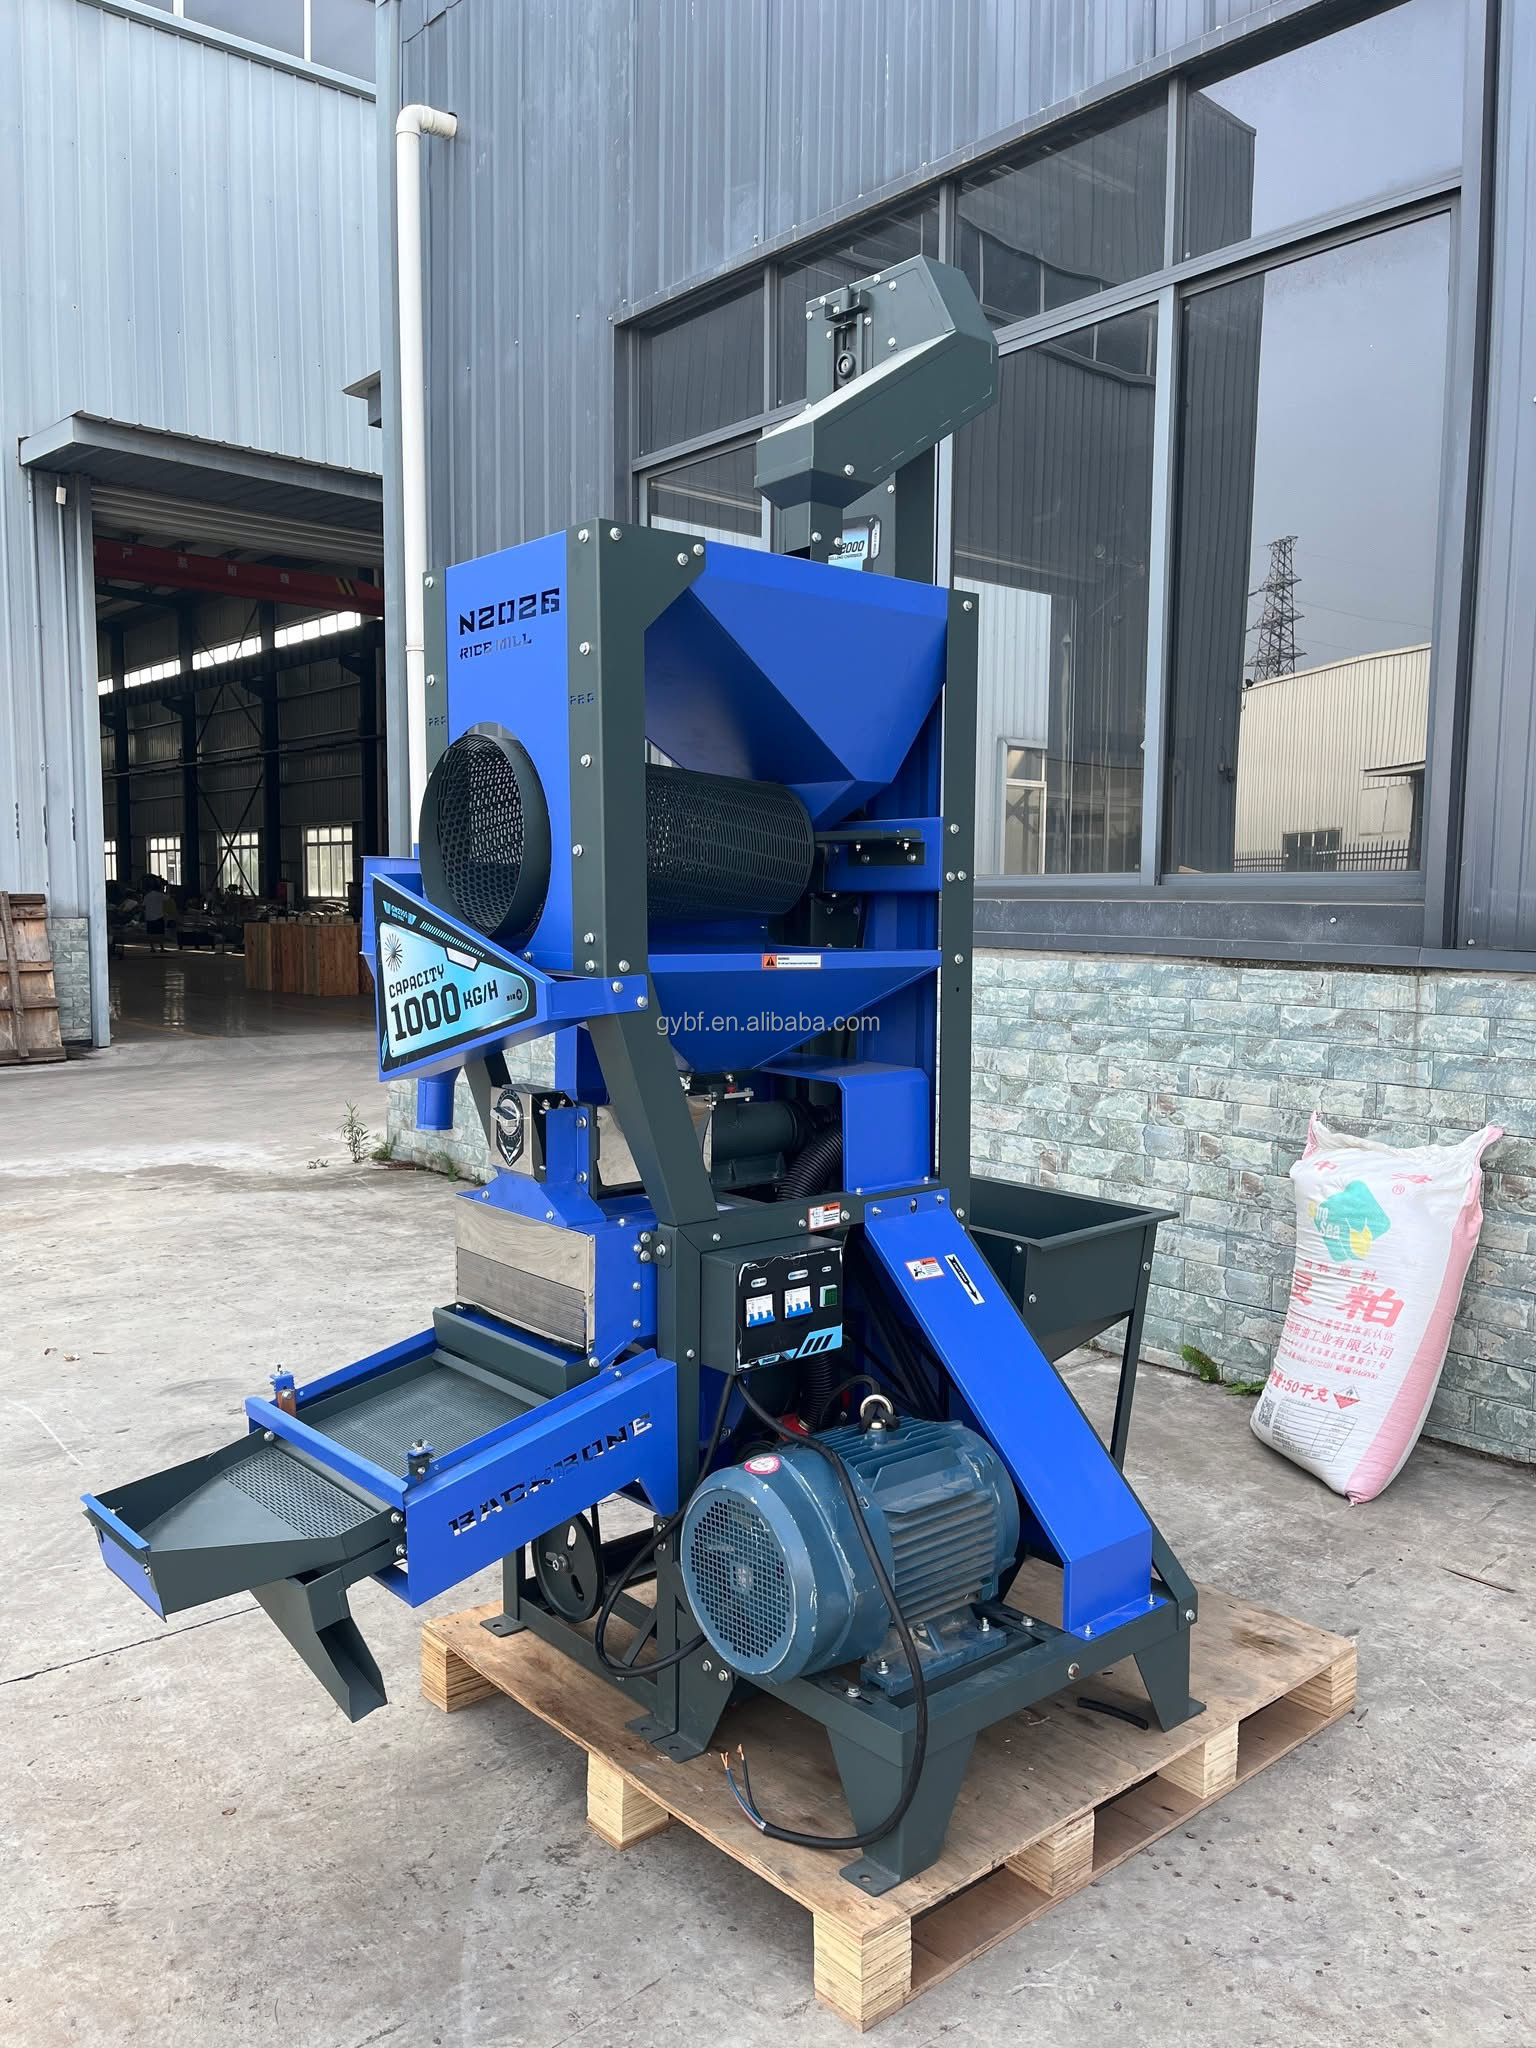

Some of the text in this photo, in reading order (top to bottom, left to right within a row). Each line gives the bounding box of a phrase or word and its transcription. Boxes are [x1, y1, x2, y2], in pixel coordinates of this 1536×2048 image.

[459, 587, 560, 636] N2026
[459, 633, 532, 660] RICE MILL
[388, 963, 445, 999] CAPACITY
[391, 979, 499, 1042] 1000 KG/H
[1319, 1220, 1342, 1240] Sea
[448, 1412, 653, 1537] BACKBONE
